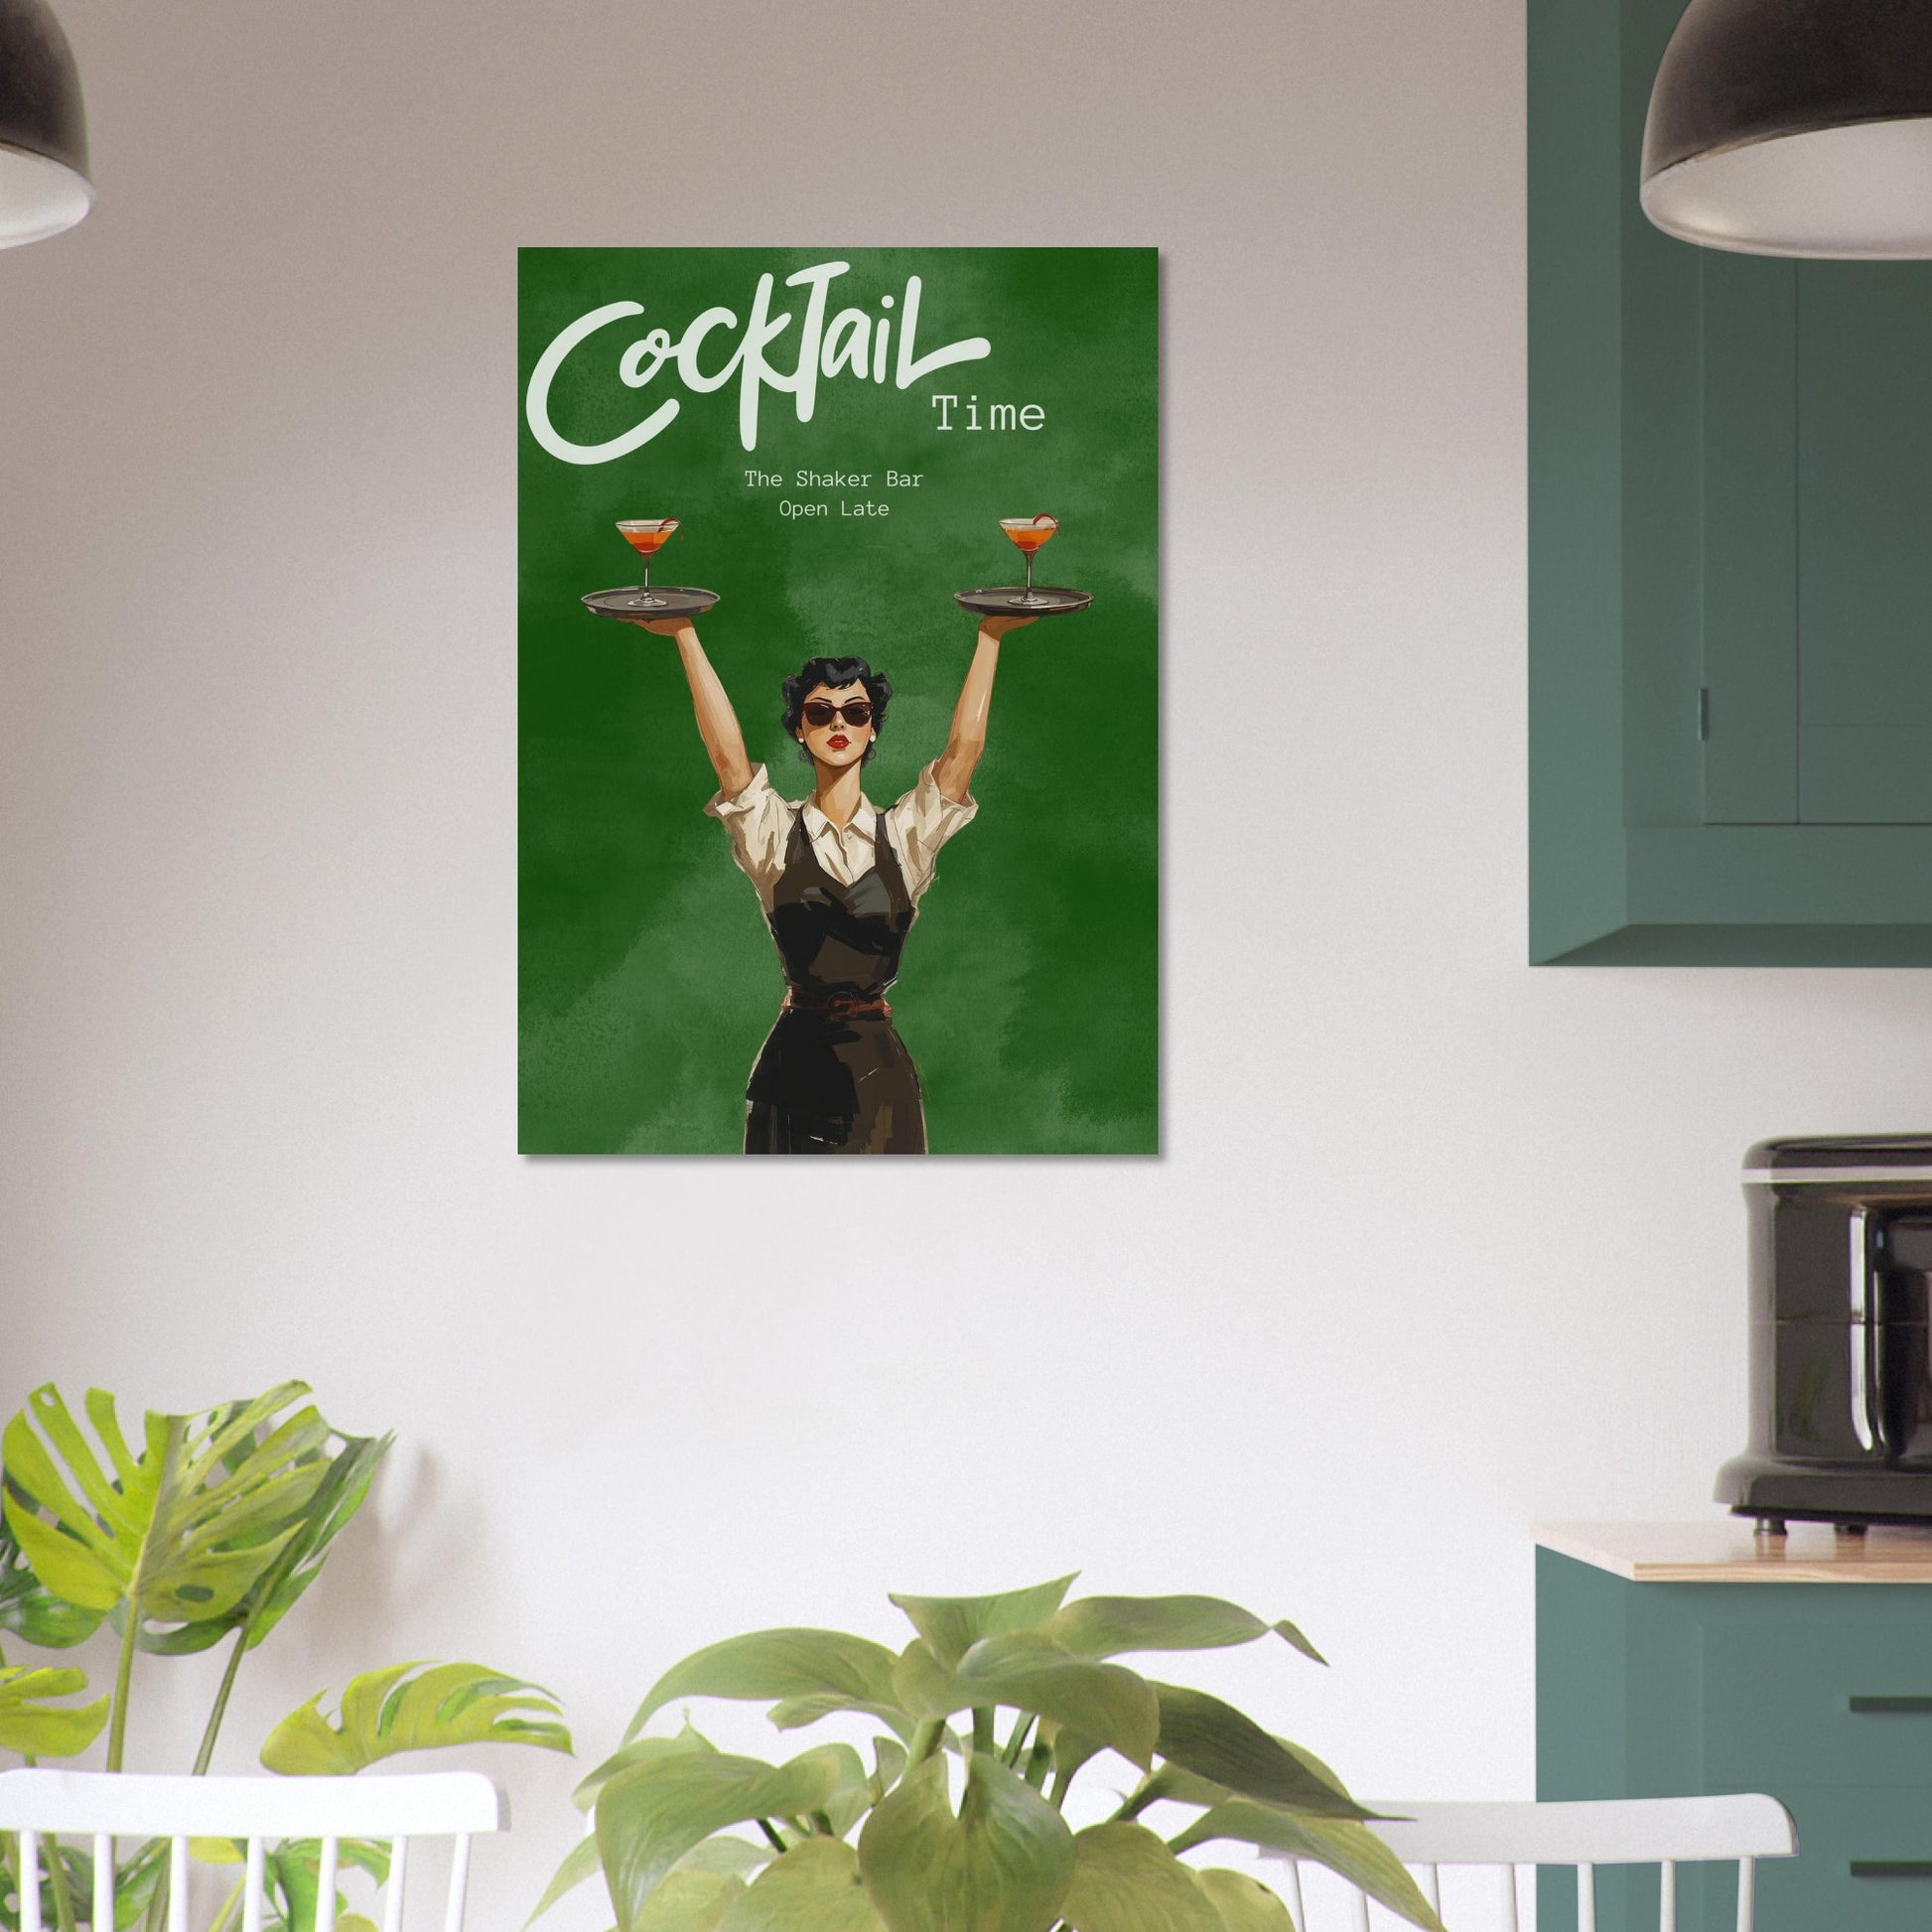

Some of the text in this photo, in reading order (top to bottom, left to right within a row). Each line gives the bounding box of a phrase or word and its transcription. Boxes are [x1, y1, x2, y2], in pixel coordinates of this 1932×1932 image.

[931, 394, 1046, 431] Time
[745, 470, 924, 487] The Shaker Bar
[778, 499, 891, 520] Open Late
